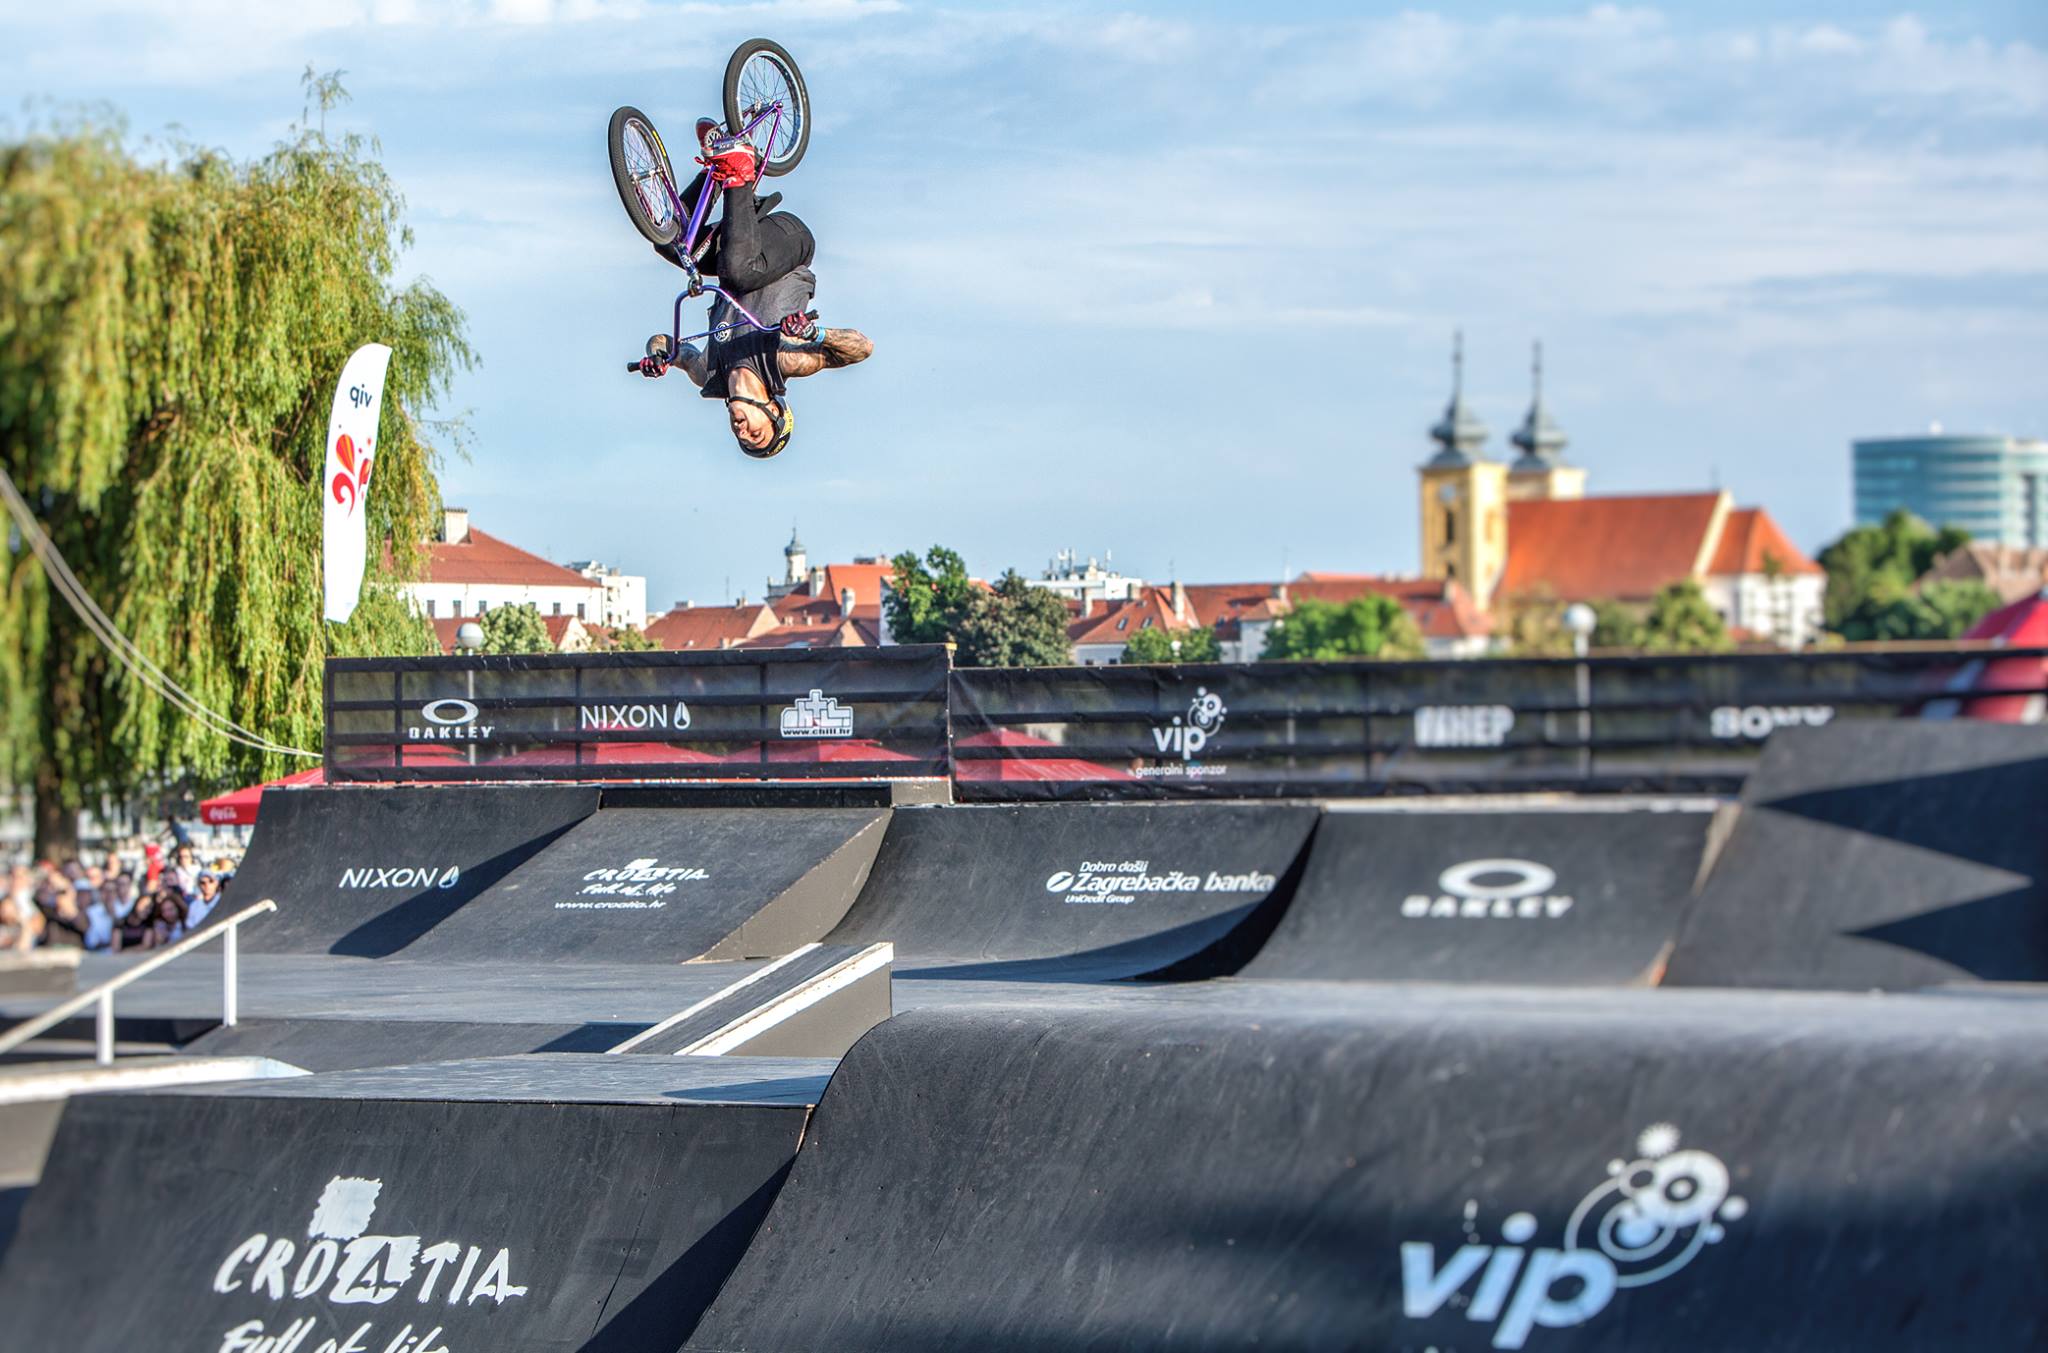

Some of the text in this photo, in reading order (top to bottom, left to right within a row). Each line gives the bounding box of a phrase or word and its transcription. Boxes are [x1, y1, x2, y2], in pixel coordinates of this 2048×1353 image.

[581, 704, 668, 729] NIXON
[408, 726, 494, 739] OAKLEY
[783, 727, 850, 736] www.chill.hr
[1151, 715, 1207, 761] vip
[1135, 762, 1228, 779] generalni sponzor
[583, 867, 710, 882] CROATIA
[1079, 860, 1149, 873] Dobro došli
[338, 867, 439, 888] NIXON
[1070, 870, 1277, 894] Zagrebačka banka
[581, 882, 625, 895] Full
[645, 882, 678, 897] life
[554, 899, 667, 909] www.croatia.hr
[1064, 894, 1136, 905] UniCredit Group
[1401, 894, 1574, 919] OAKLEY
[213, 1233, 528, 1306] CROATIA
[1400, 1211, 1618, 1350] vip
